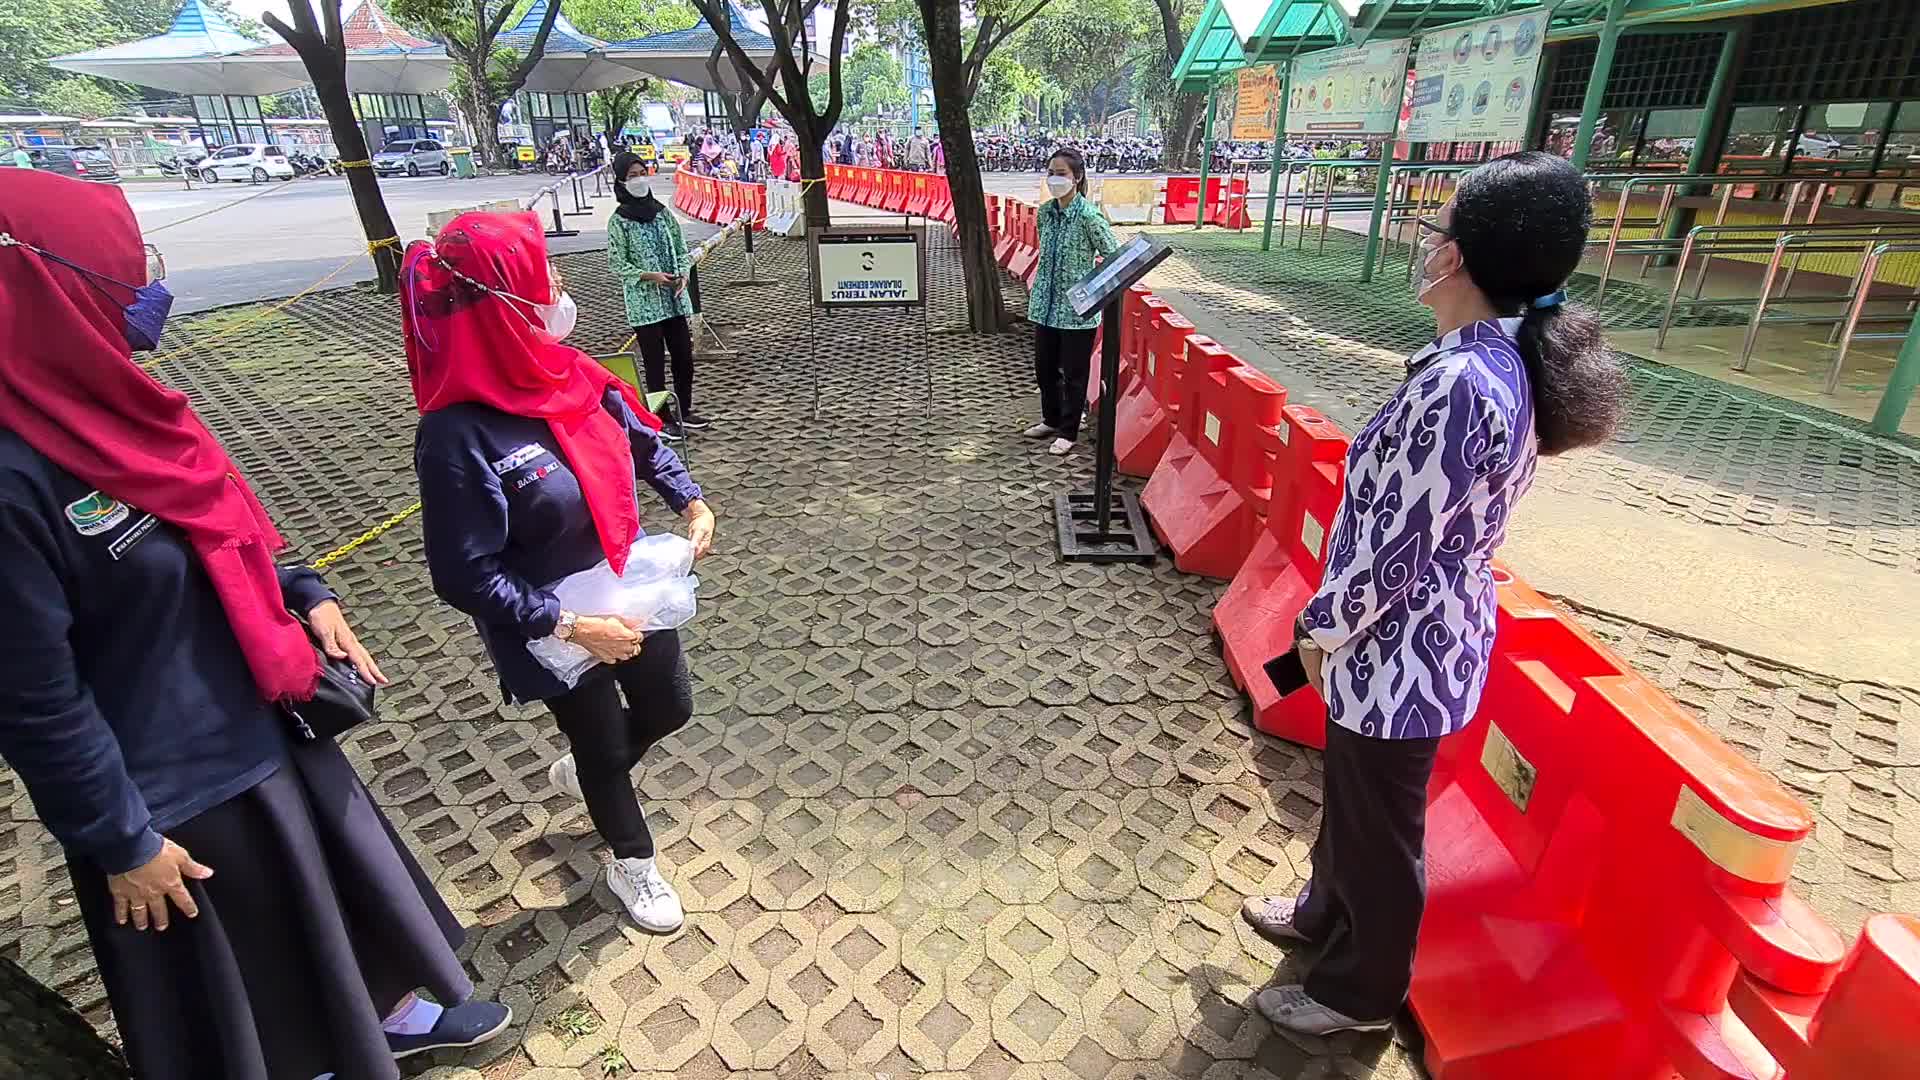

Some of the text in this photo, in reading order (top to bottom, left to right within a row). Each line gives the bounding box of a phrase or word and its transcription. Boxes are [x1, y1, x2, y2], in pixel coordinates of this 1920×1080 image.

[838, 280, 902, 289] DILARANG BERHENTI
[831, 289, 907, 299] JALAN TERUS
